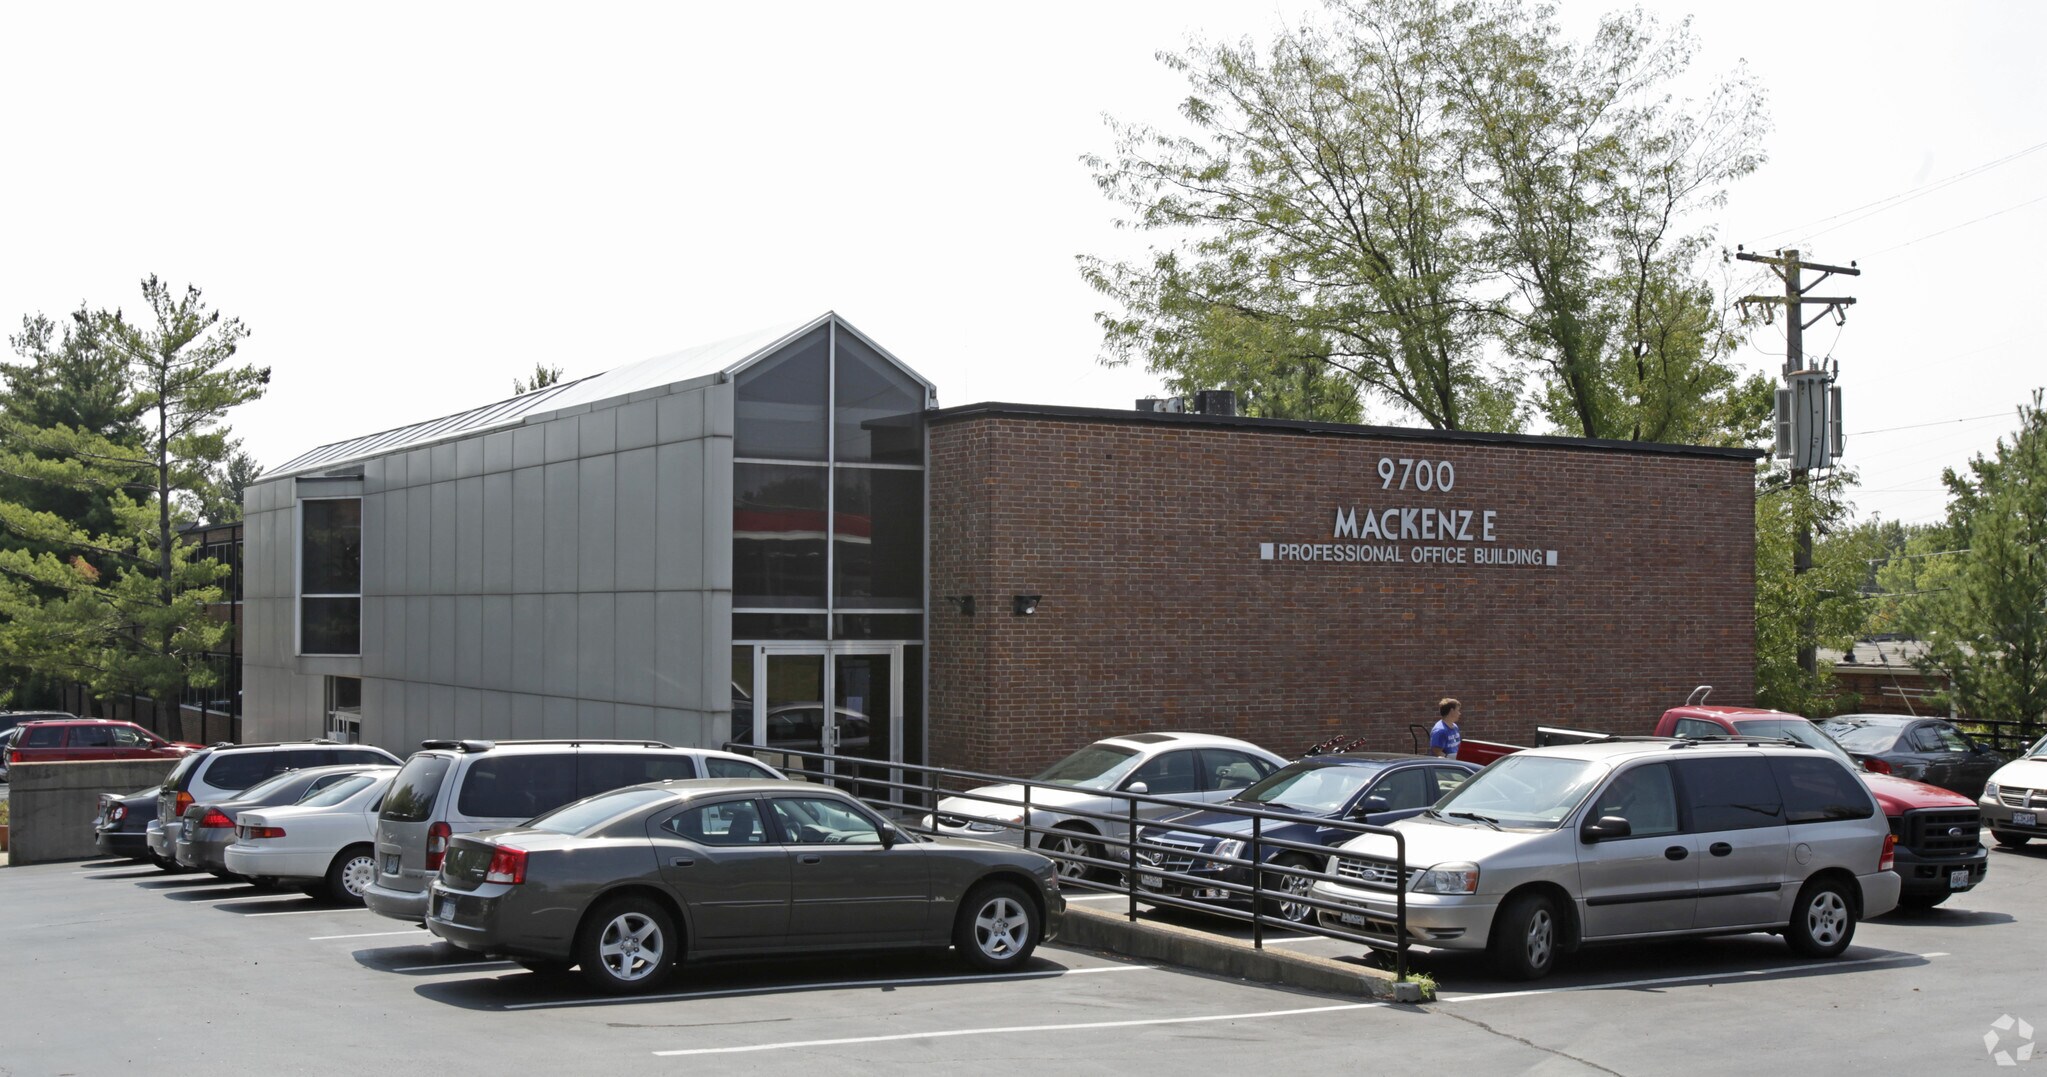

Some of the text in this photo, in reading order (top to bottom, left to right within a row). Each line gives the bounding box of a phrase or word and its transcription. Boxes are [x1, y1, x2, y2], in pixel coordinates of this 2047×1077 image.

[1377, 457, 1455, 492] 9700
[1278, 543, 1543, 565] PROFESSIONAL OFFICE BUILDING
